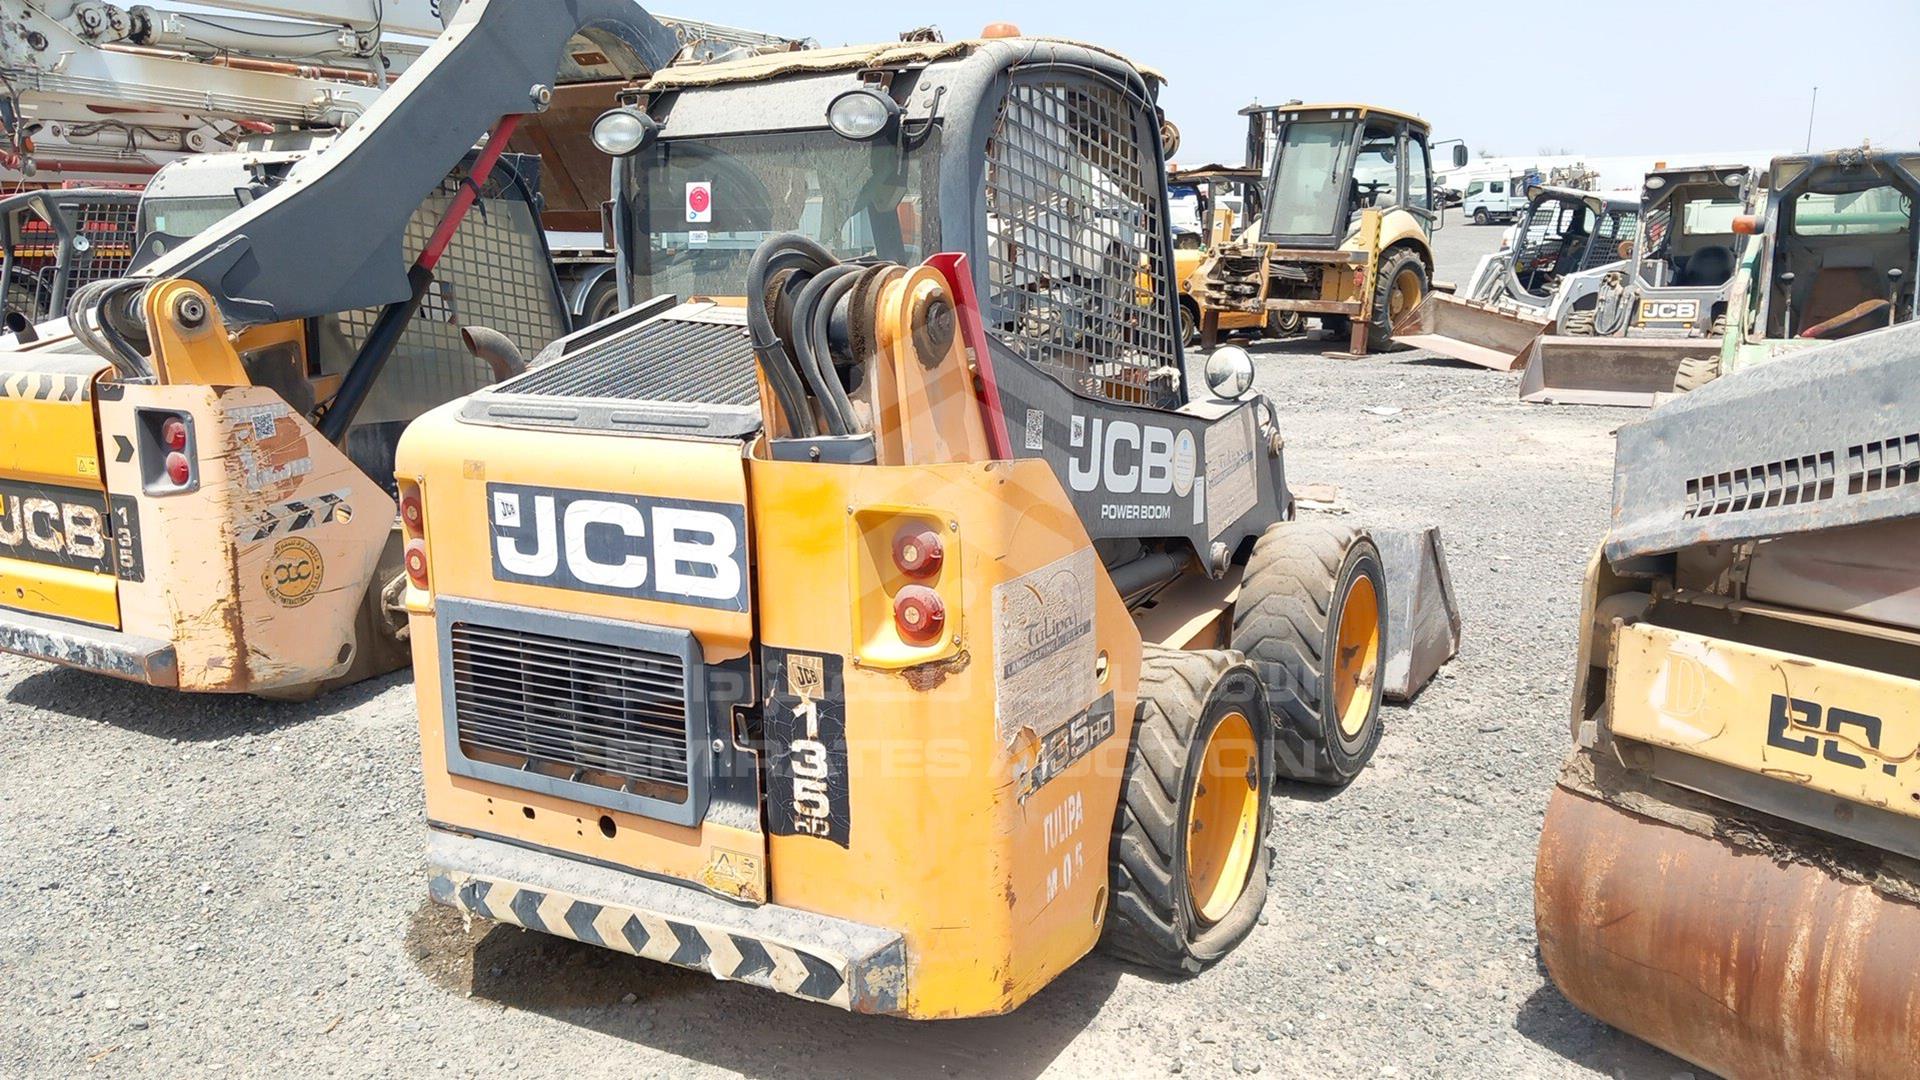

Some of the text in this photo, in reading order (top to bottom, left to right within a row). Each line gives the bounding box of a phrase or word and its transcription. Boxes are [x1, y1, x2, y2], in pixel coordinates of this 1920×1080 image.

[1643, 303, 1695, 318] JCB
[1069, 414, 1175, 494] JCB
[0, 495, 105, 560] JCB
[114, 506, 135, 569] 135
[493, 491, 742, 600] JCB
[797, 665, 818, 686] JCB
[791, 701, 831, 819] 135
[1043, 790, 1084, 854] TULIPA
